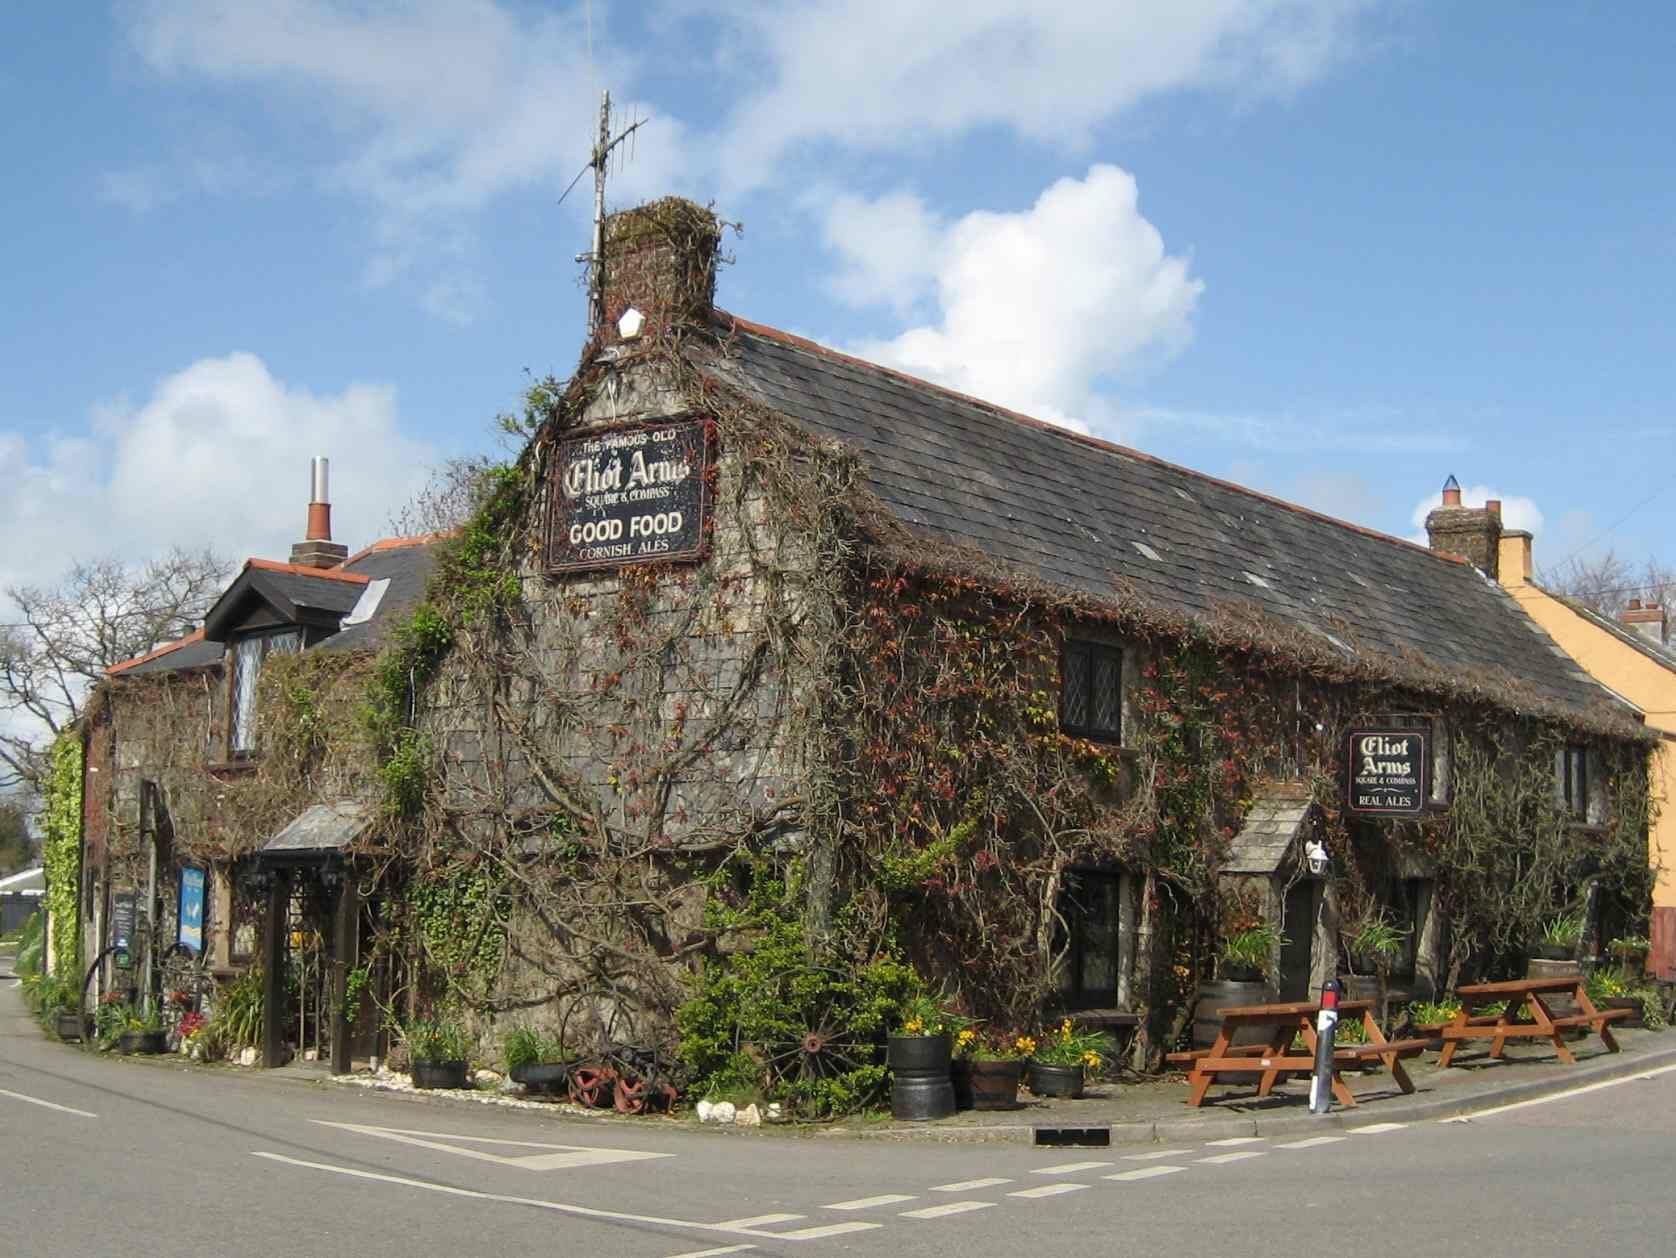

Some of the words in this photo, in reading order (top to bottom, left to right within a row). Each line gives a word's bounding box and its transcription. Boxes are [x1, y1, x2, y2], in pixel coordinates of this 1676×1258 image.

[583, 441, 601, 452] THE
[653, 430, 676, 442] OLD
[565, 456, 623, 496] Eliot
[625, 451, 690, 490] Arms
[570, 519, 623, 544] GOOD
[630, 512, 682, 537] FOOD
[580, 545, 632, 560] CORNISH
[638, 539, 669, 554] ALES
[1360, 736, 1408, 756] Eliot
[1361, 757, 1411, 776] Arms
[1360, 796, 1382, 806] REAL
[1386, 796, 1411, 806] ALES
